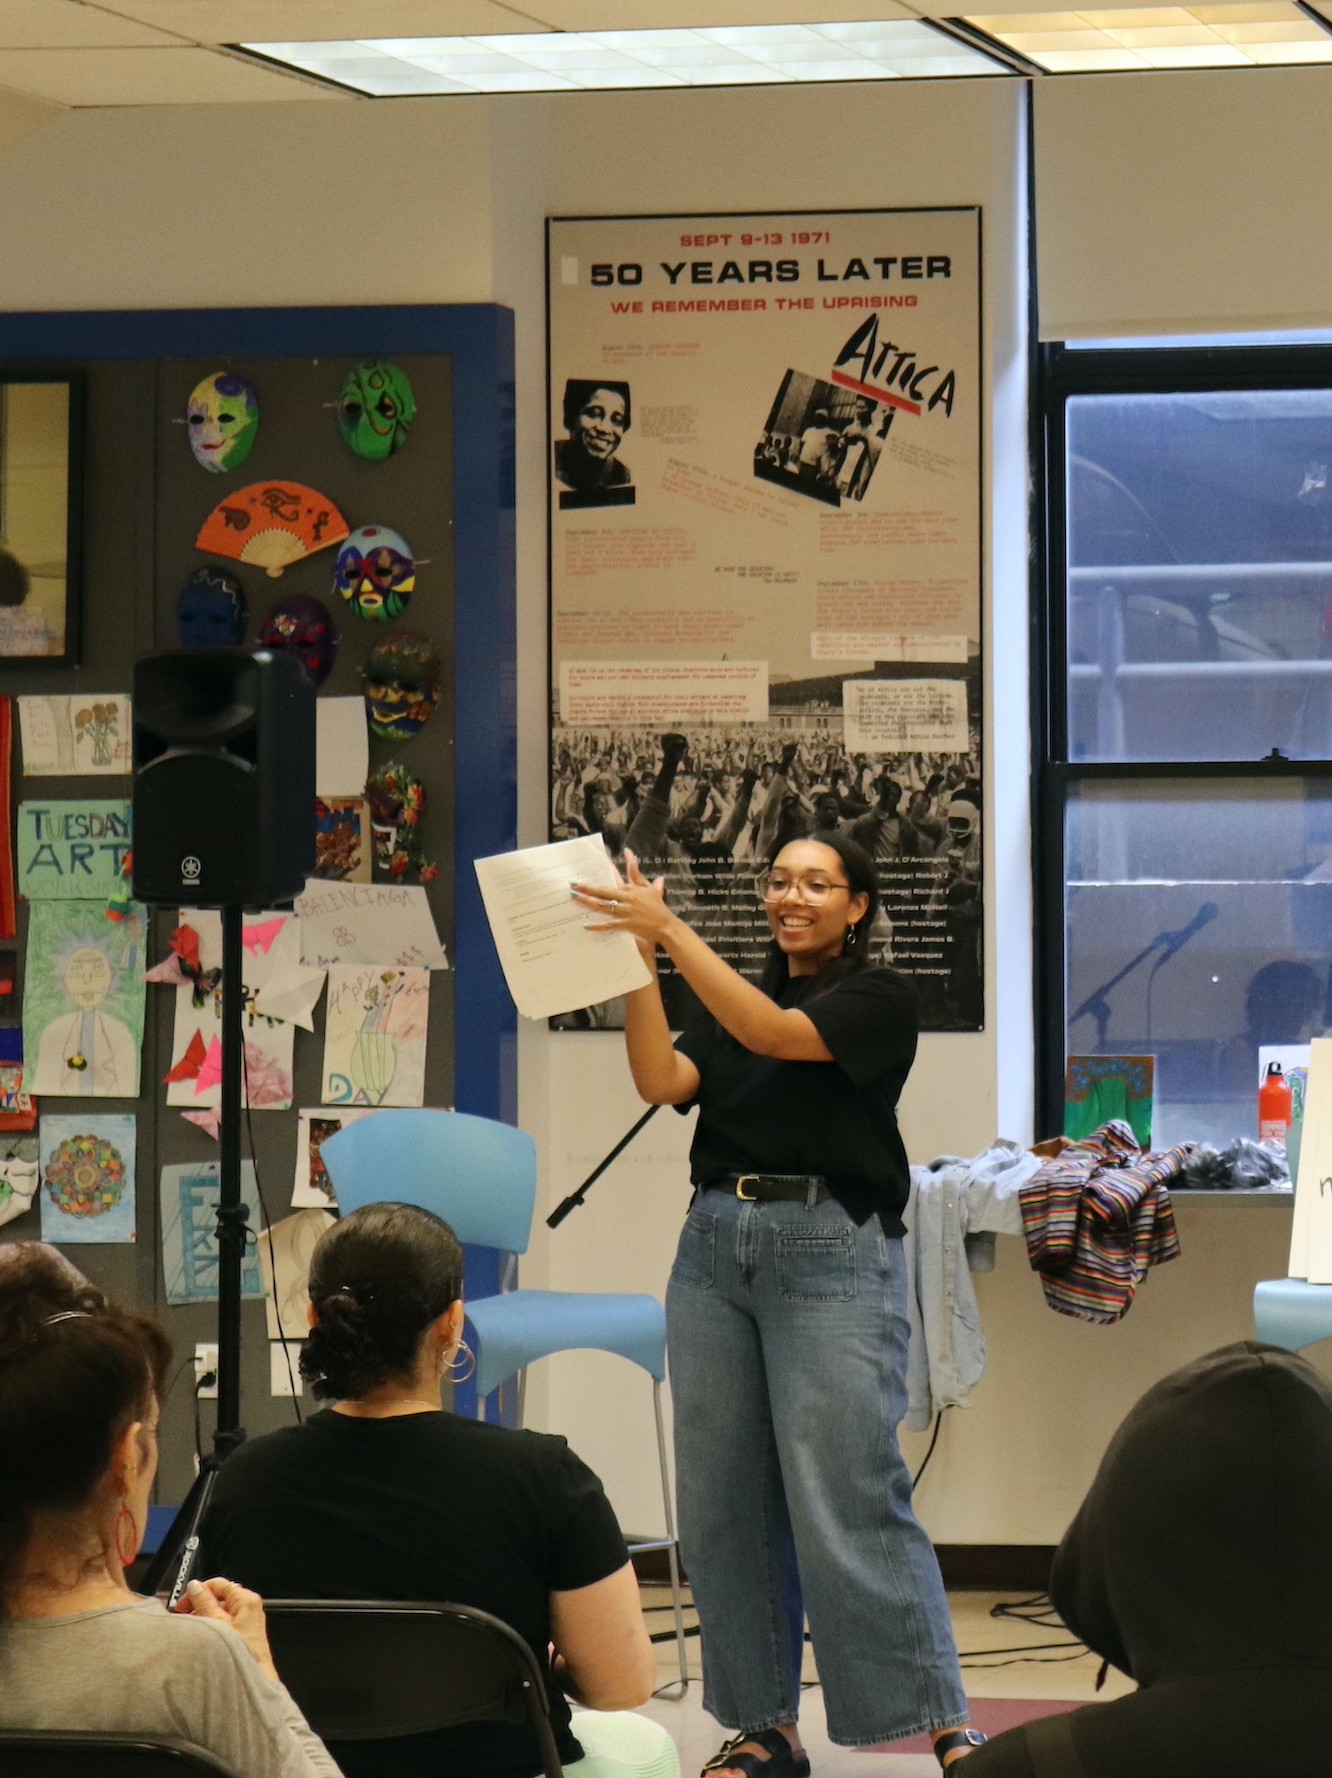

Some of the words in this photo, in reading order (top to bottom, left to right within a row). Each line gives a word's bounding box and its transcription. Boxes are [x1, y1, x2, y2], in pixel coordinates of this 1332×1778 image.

[680, 234, 732, 247] SEPT
[741, 233, 783, 246] 9-13
[791, 232, 830, 244] 1971
[590, 263, 642, 287] 50
[660, 259, 799, 284] YEARS
[817, 256, 951, 281] LATER
[611, 302, 643, 314] WE
[652, 299, 766, 312] REMEMBER
[775, 298, 814, 310] THE
[823, 295, 918, 309] UPRISING
[27, 809, 130, 840] TUESDAY
[26, 843, 132, 876] ART
